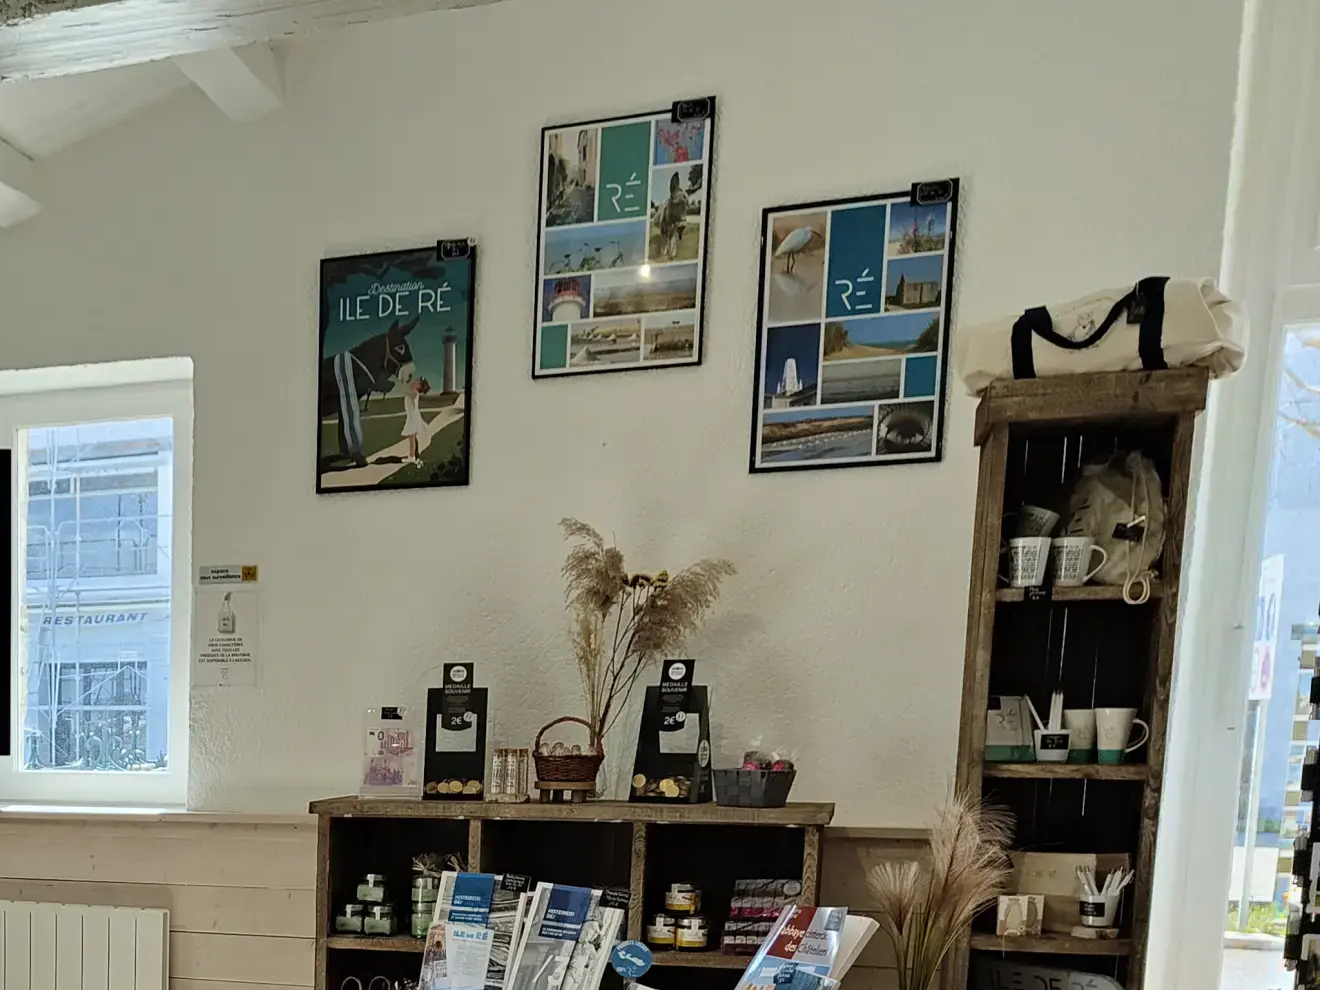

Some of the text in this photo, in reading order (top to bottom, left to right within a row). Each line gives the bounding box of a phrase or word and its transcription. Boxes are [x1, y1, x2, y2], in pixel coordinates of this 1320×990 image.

[606, 172, 640, 212] RÉ
[368, 280, 425, 295] Destination
[835, 267, 875, 310] RÉ
[340, 282, 451, 321] ILE DE RÉ
[43, 612, 149, 627] RESTAURANT
[451, 717, 463, 725] 2€
[664, 716, 675, 725] 2€
